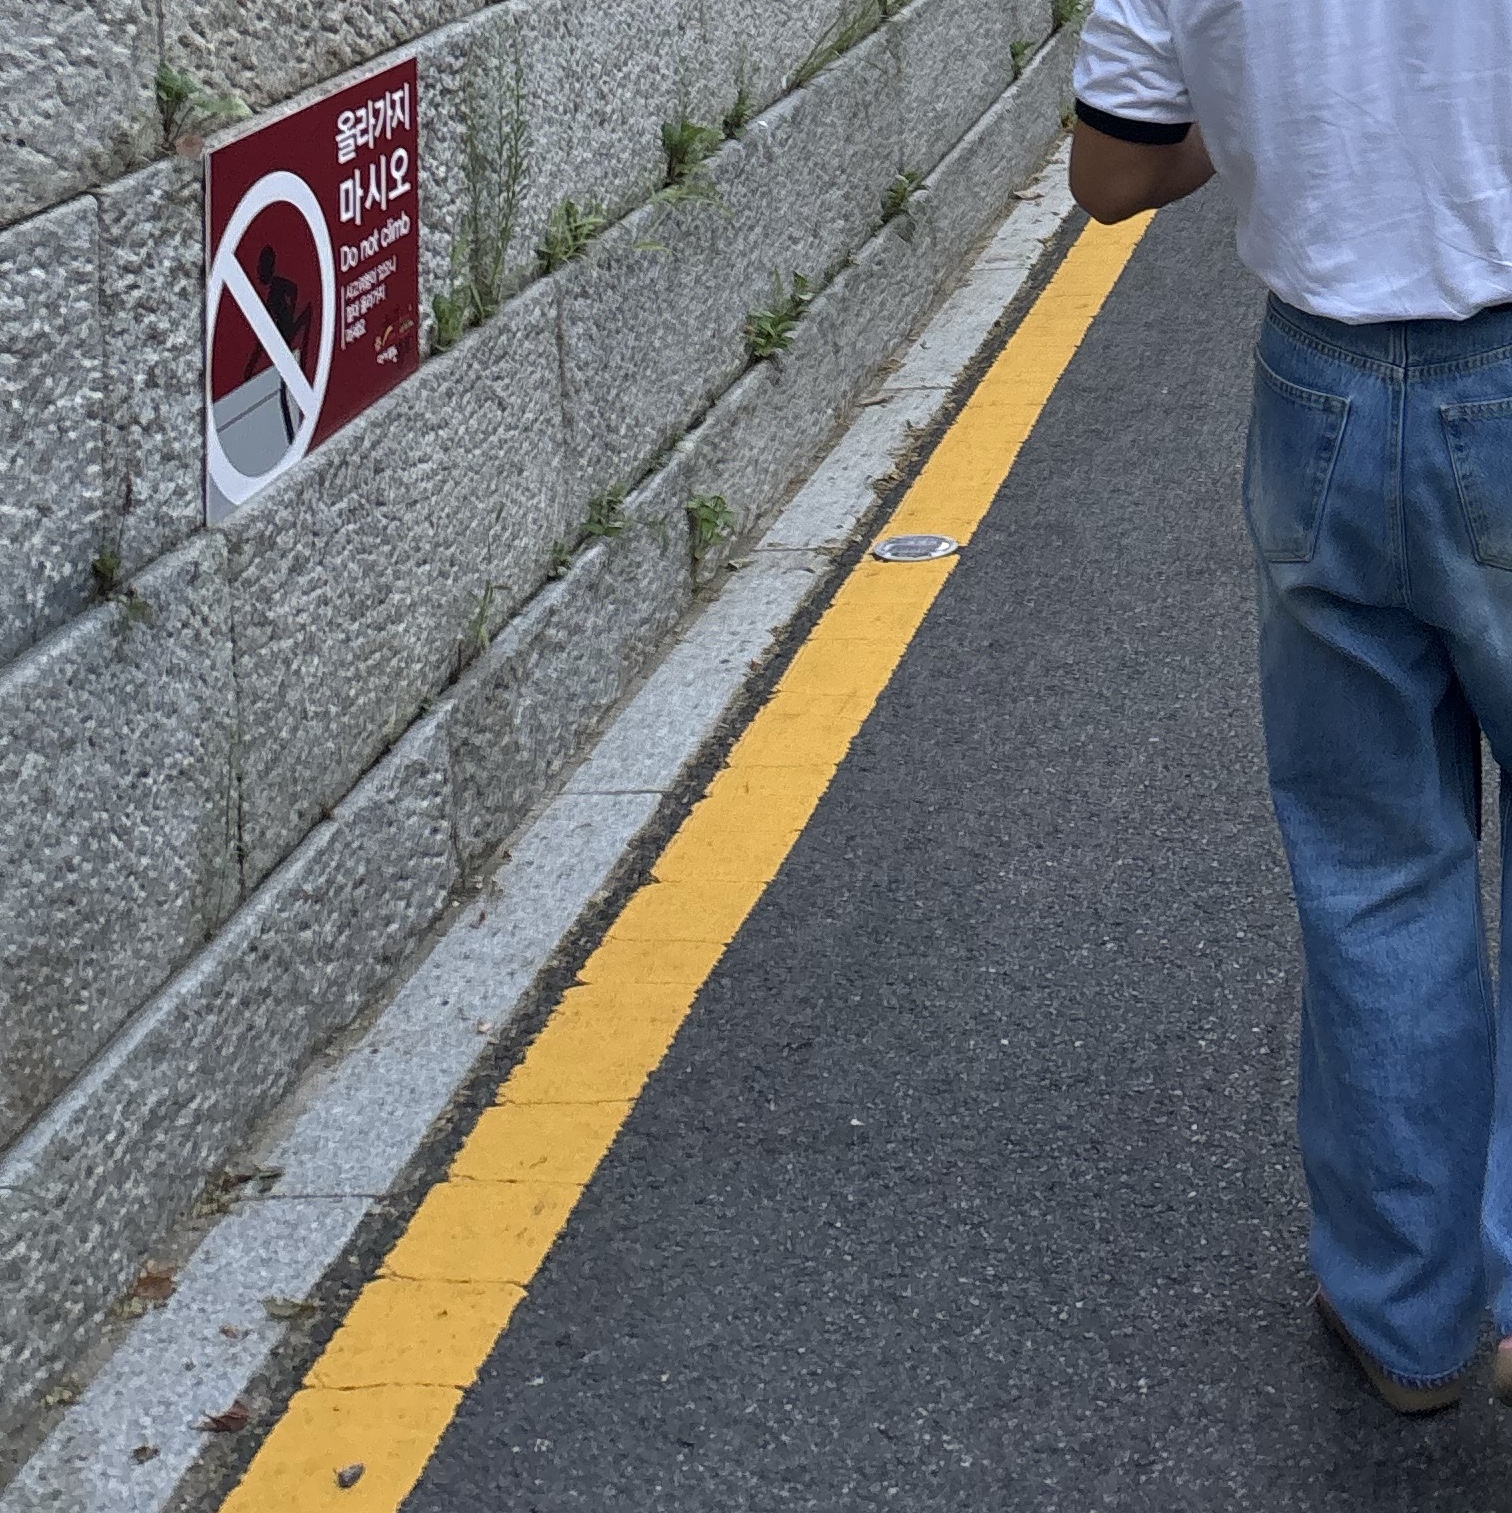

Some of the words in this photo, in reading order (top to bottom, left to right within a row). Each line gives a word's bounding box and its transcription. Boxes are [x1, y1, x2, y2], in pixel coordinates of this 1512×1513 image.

[335, 82, 411, 164] 올라가지
[339, 147, 412, 226] 마시오
[340, 245, 359, 273] Do
[360, 228, 380, 262] not
[381, 210, 411, 248] climb
